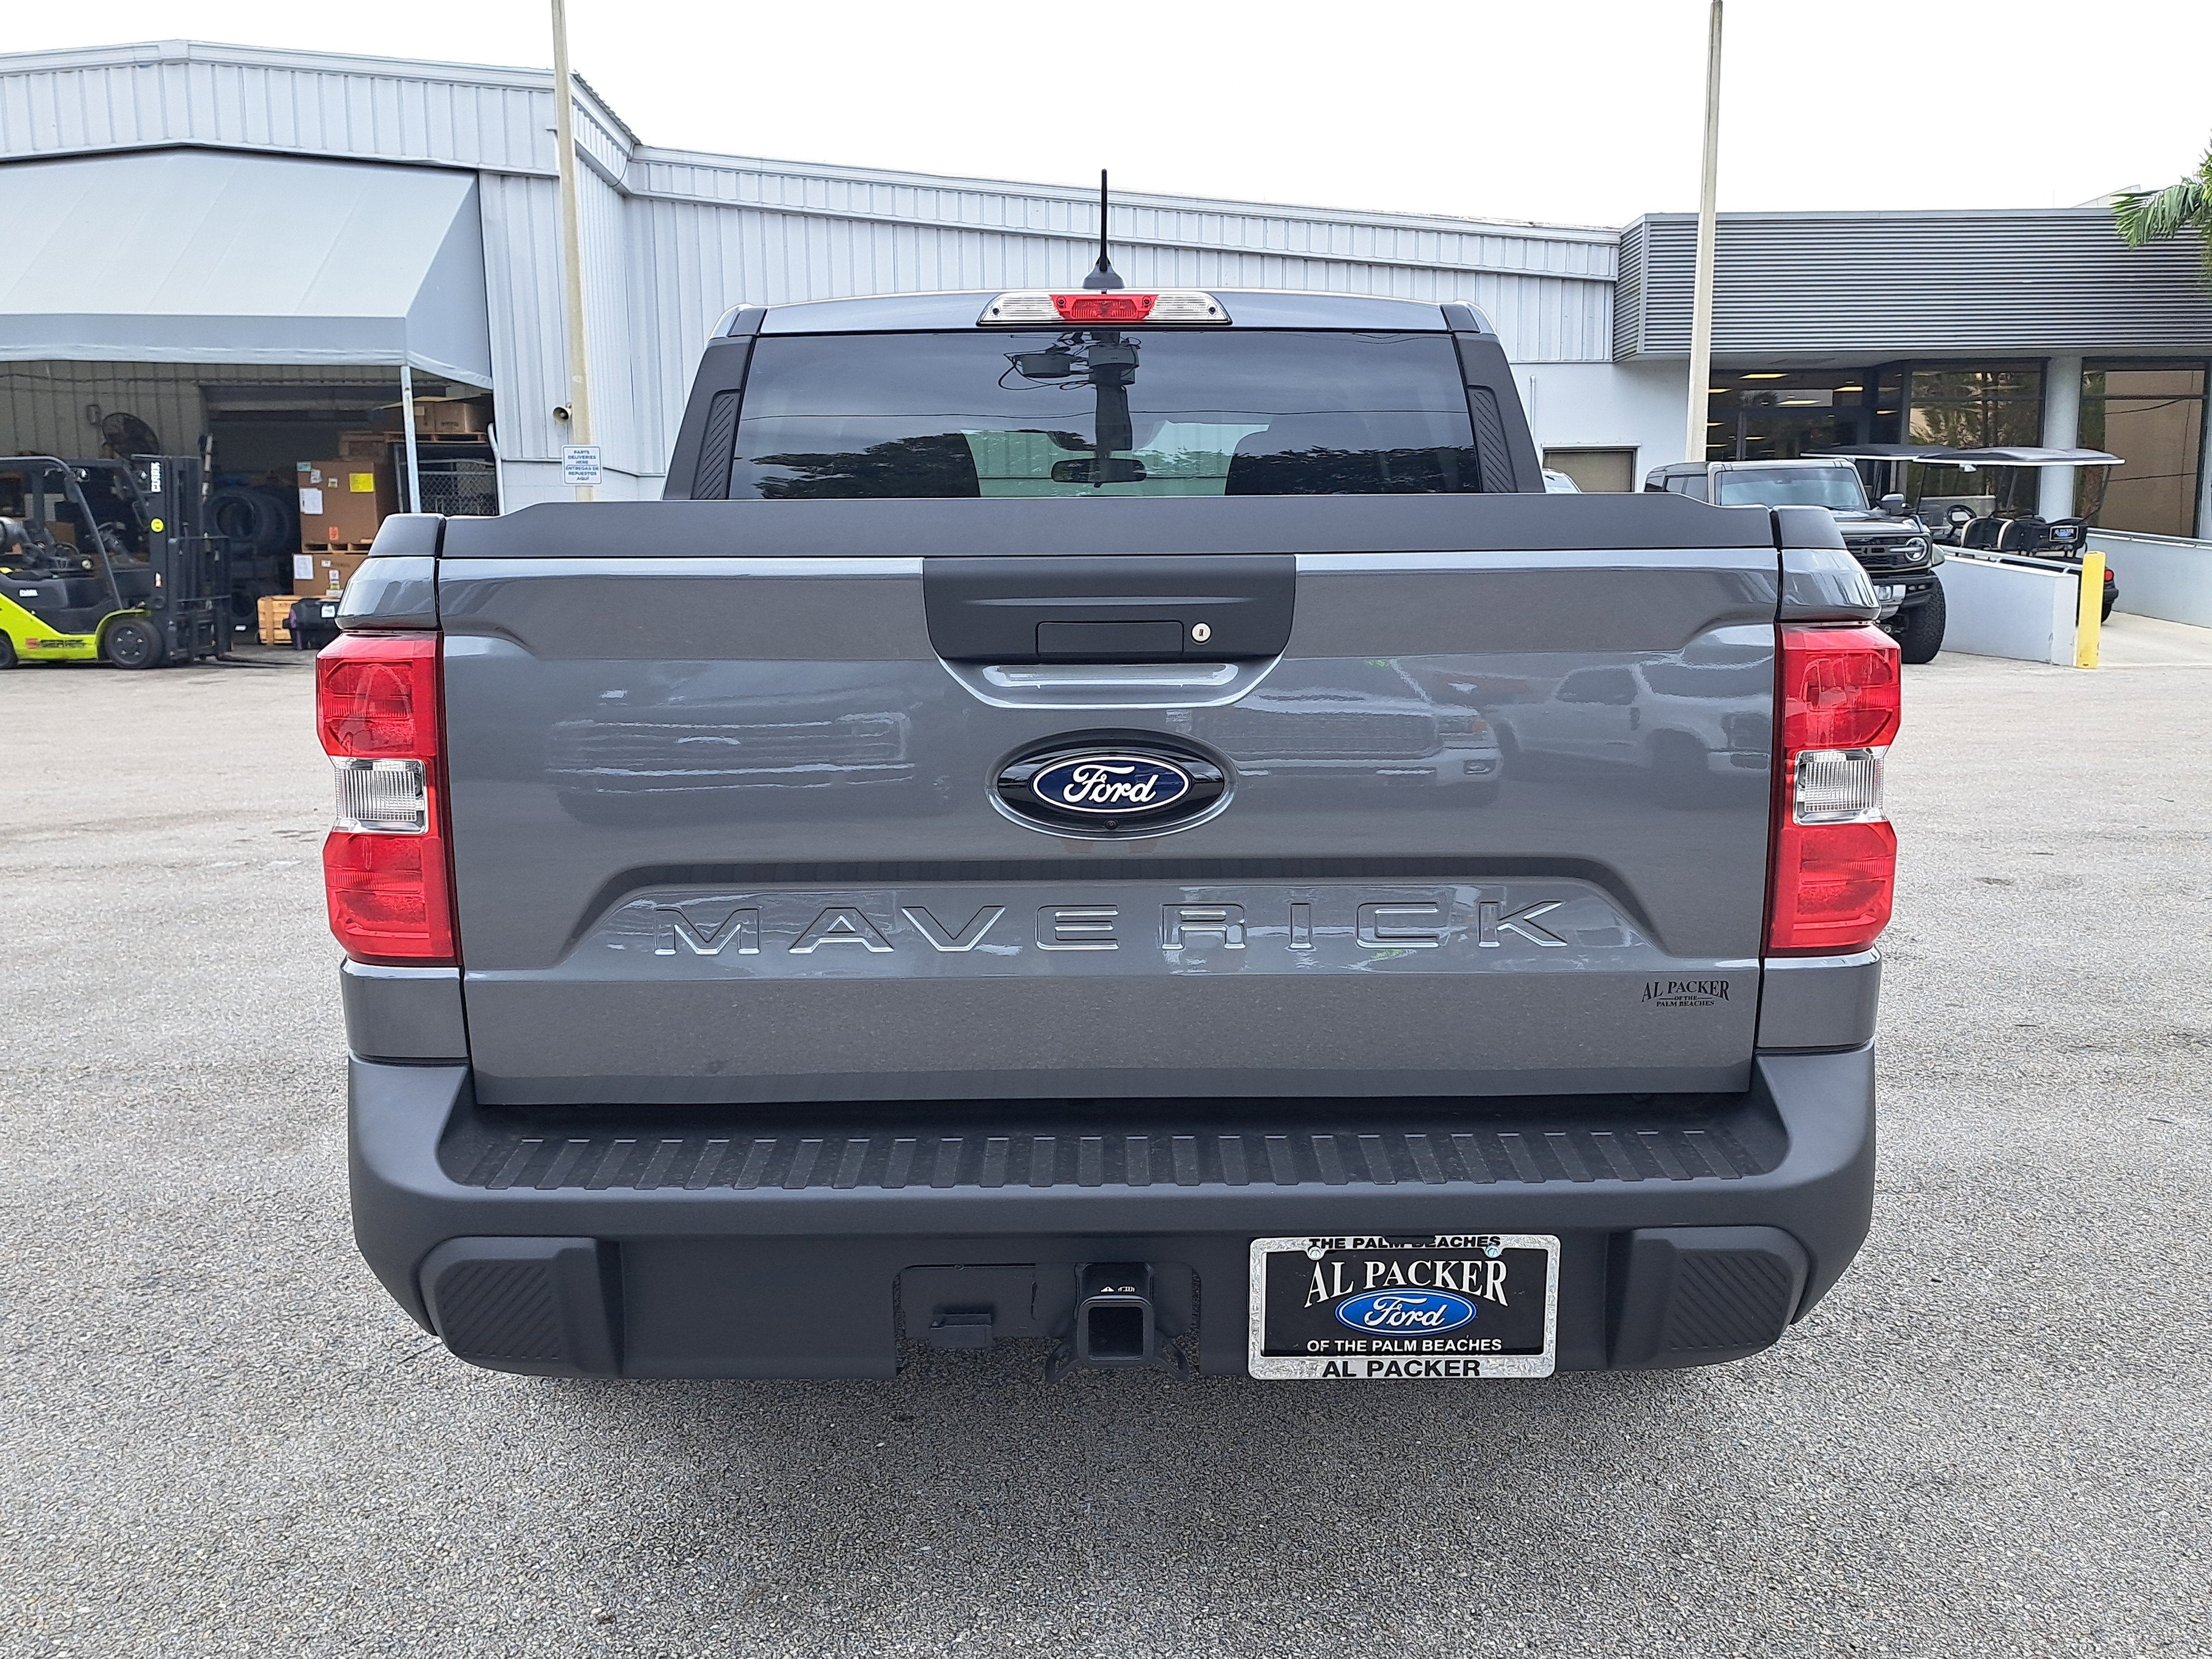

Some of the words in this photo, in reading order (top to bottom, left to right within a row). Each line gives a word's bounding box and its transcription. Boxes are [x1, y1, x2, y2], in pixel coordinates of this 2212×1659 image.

[1063, 765, 1157, 803] Ford
[655, 900, 1569, 955] MAVERICK
[1641, 982, 1664, 1002] AL
[1667, 980, 1730, 1001] PACKER
[1309, 1238, 1346, 1249] THE
[1304, 1261, 1354, 1308] AL
[1363, 1260, 1508, 1307] PACKER
[1365, 1296, 1449, 1327] Ford
[1306, 1339, 1329, 1352] OF
[1334, 1339, 1367, 1352] THE
[1372, 1339, 1416, 1351] PALM
[1422, 1338, 1502, 1351] BEACHES
[1322, 1360, 1357, 1378] AL
[1367, 1360, 1481, 1377] PACKER
